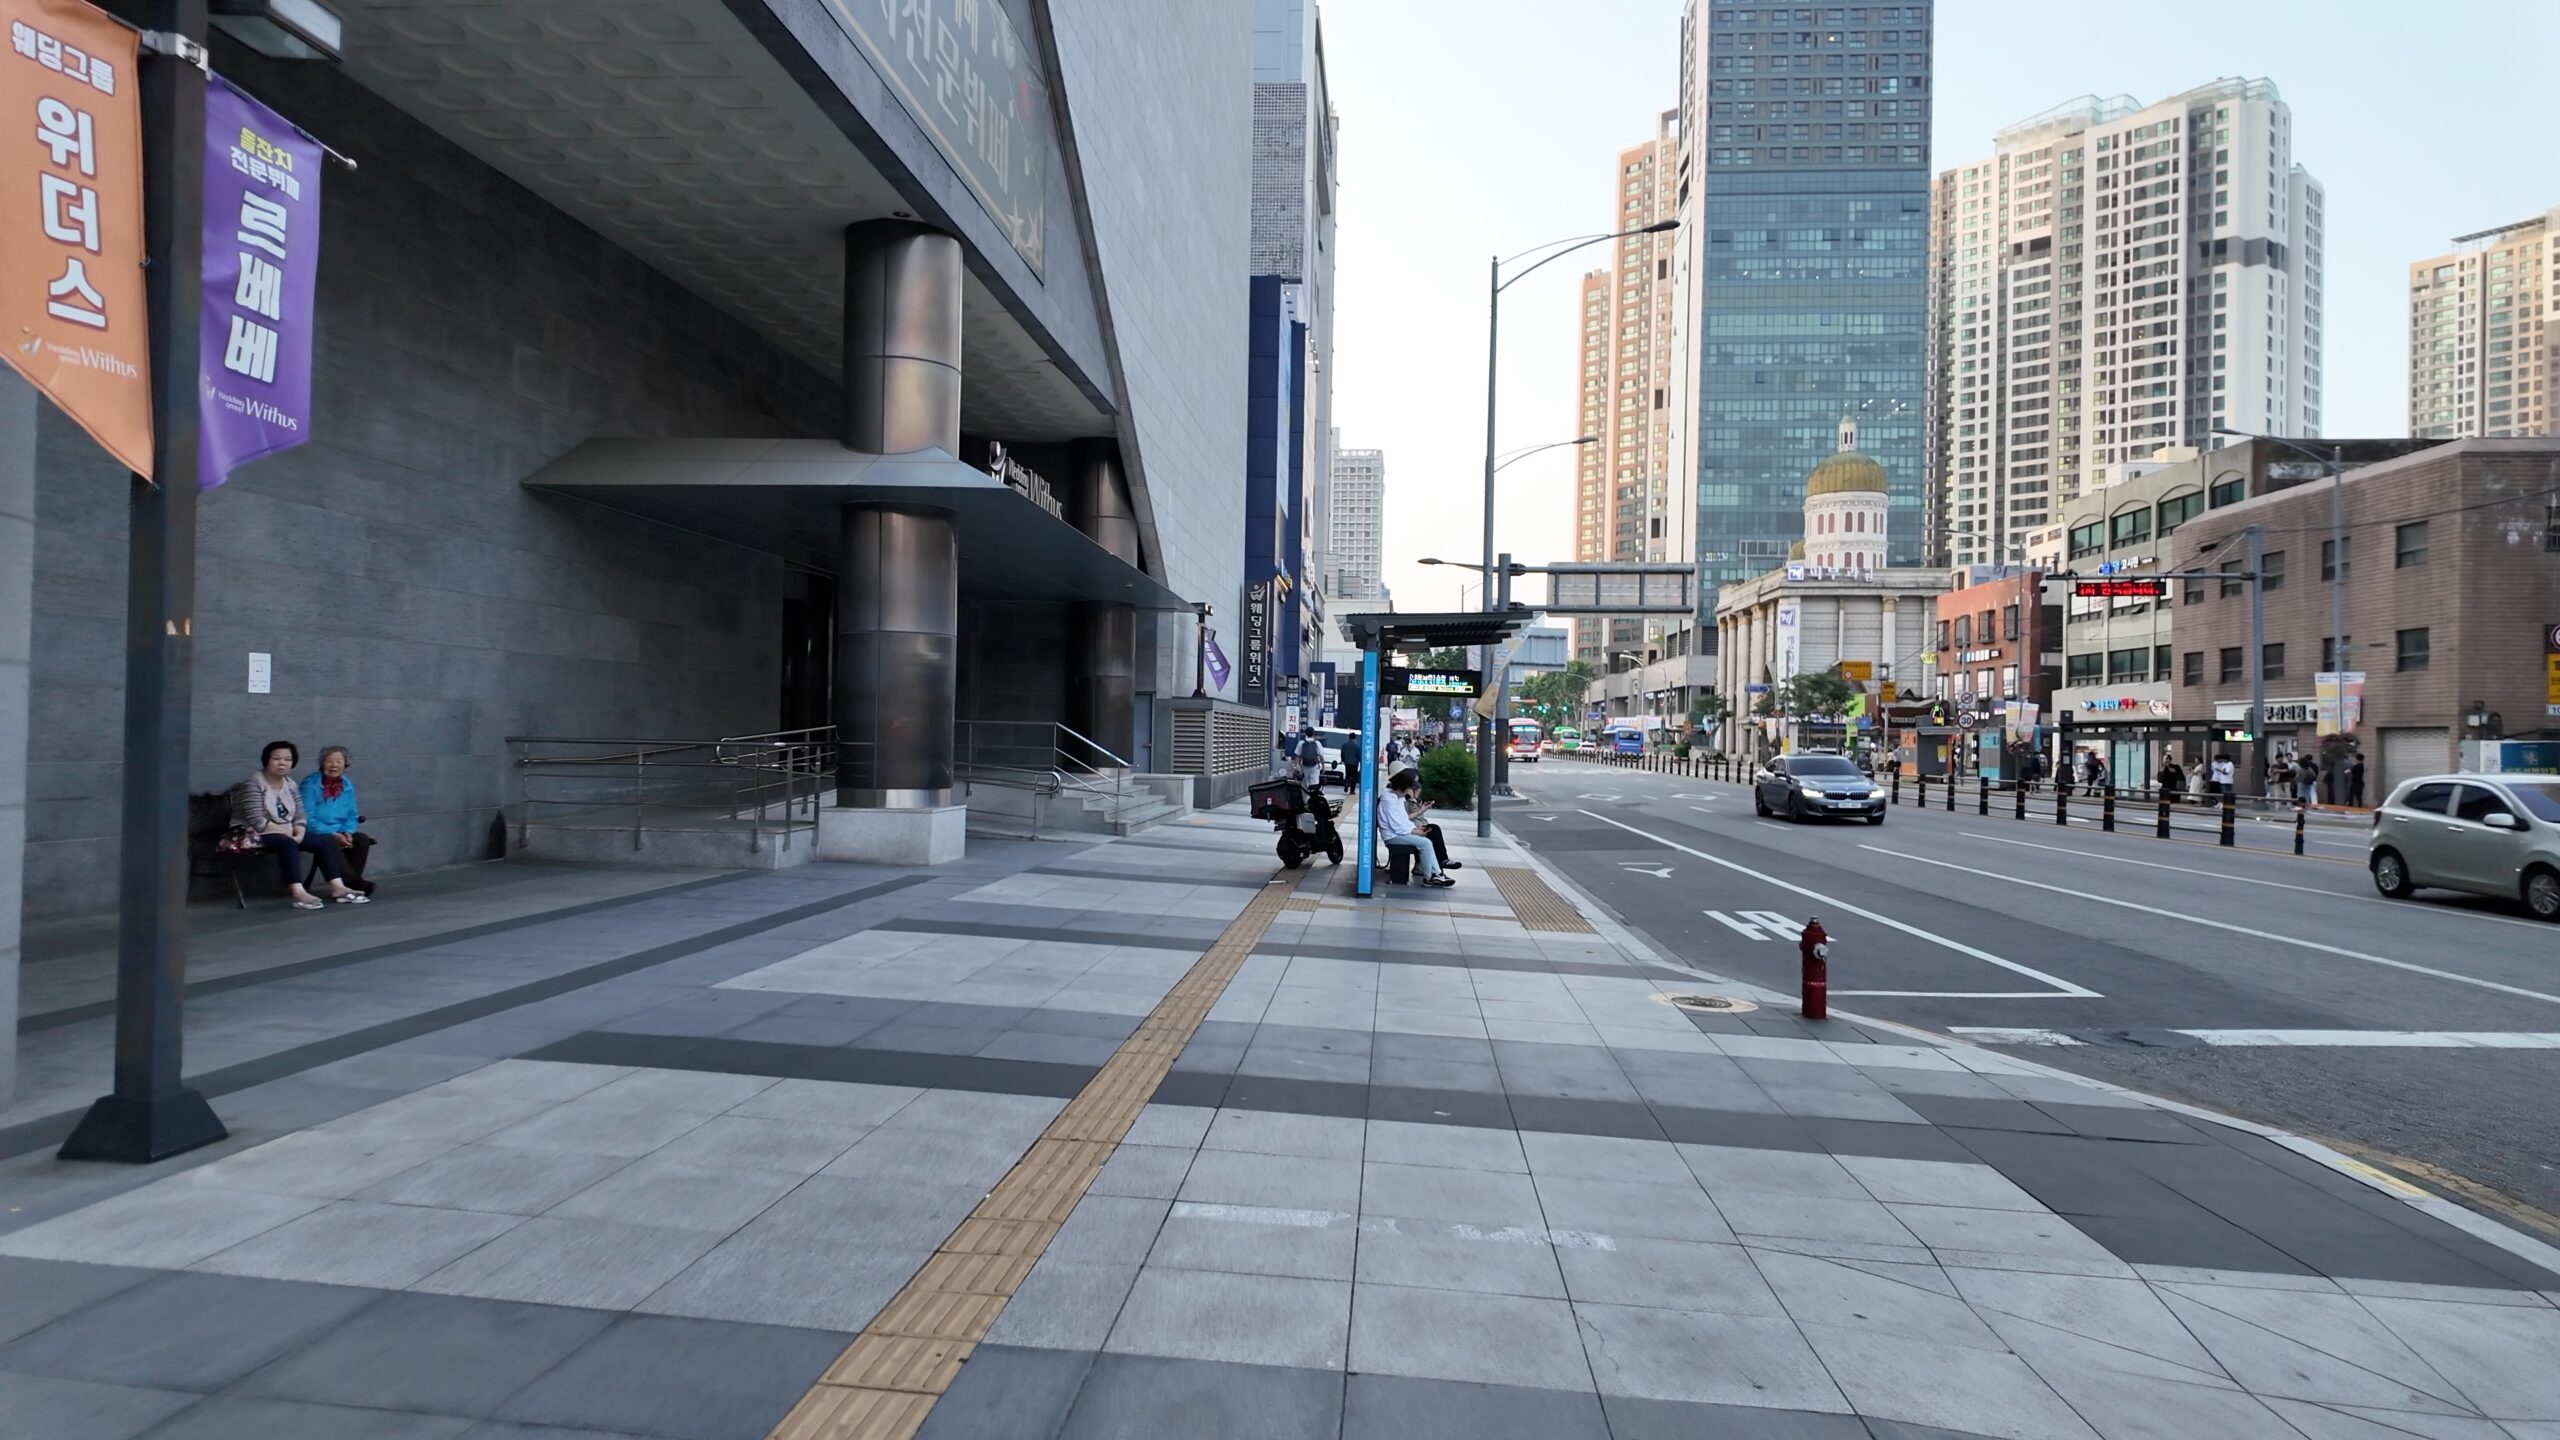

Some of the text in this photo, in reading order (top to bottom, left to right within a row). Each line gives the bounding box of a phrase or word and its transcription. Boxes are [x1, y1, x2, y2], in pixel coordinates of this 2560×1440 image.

[11, 20, 116, 96] 웨딩그룹
[229, 145, 300, 202] 전문뷔페
[36, 96, 107, 329] 위더스
[224, 189, 288, 384] 르베베
[81, 345, 138, 379] Withus
[246, 398, 298, 431] Withus
[1961, 715, 1973, 726] 30
